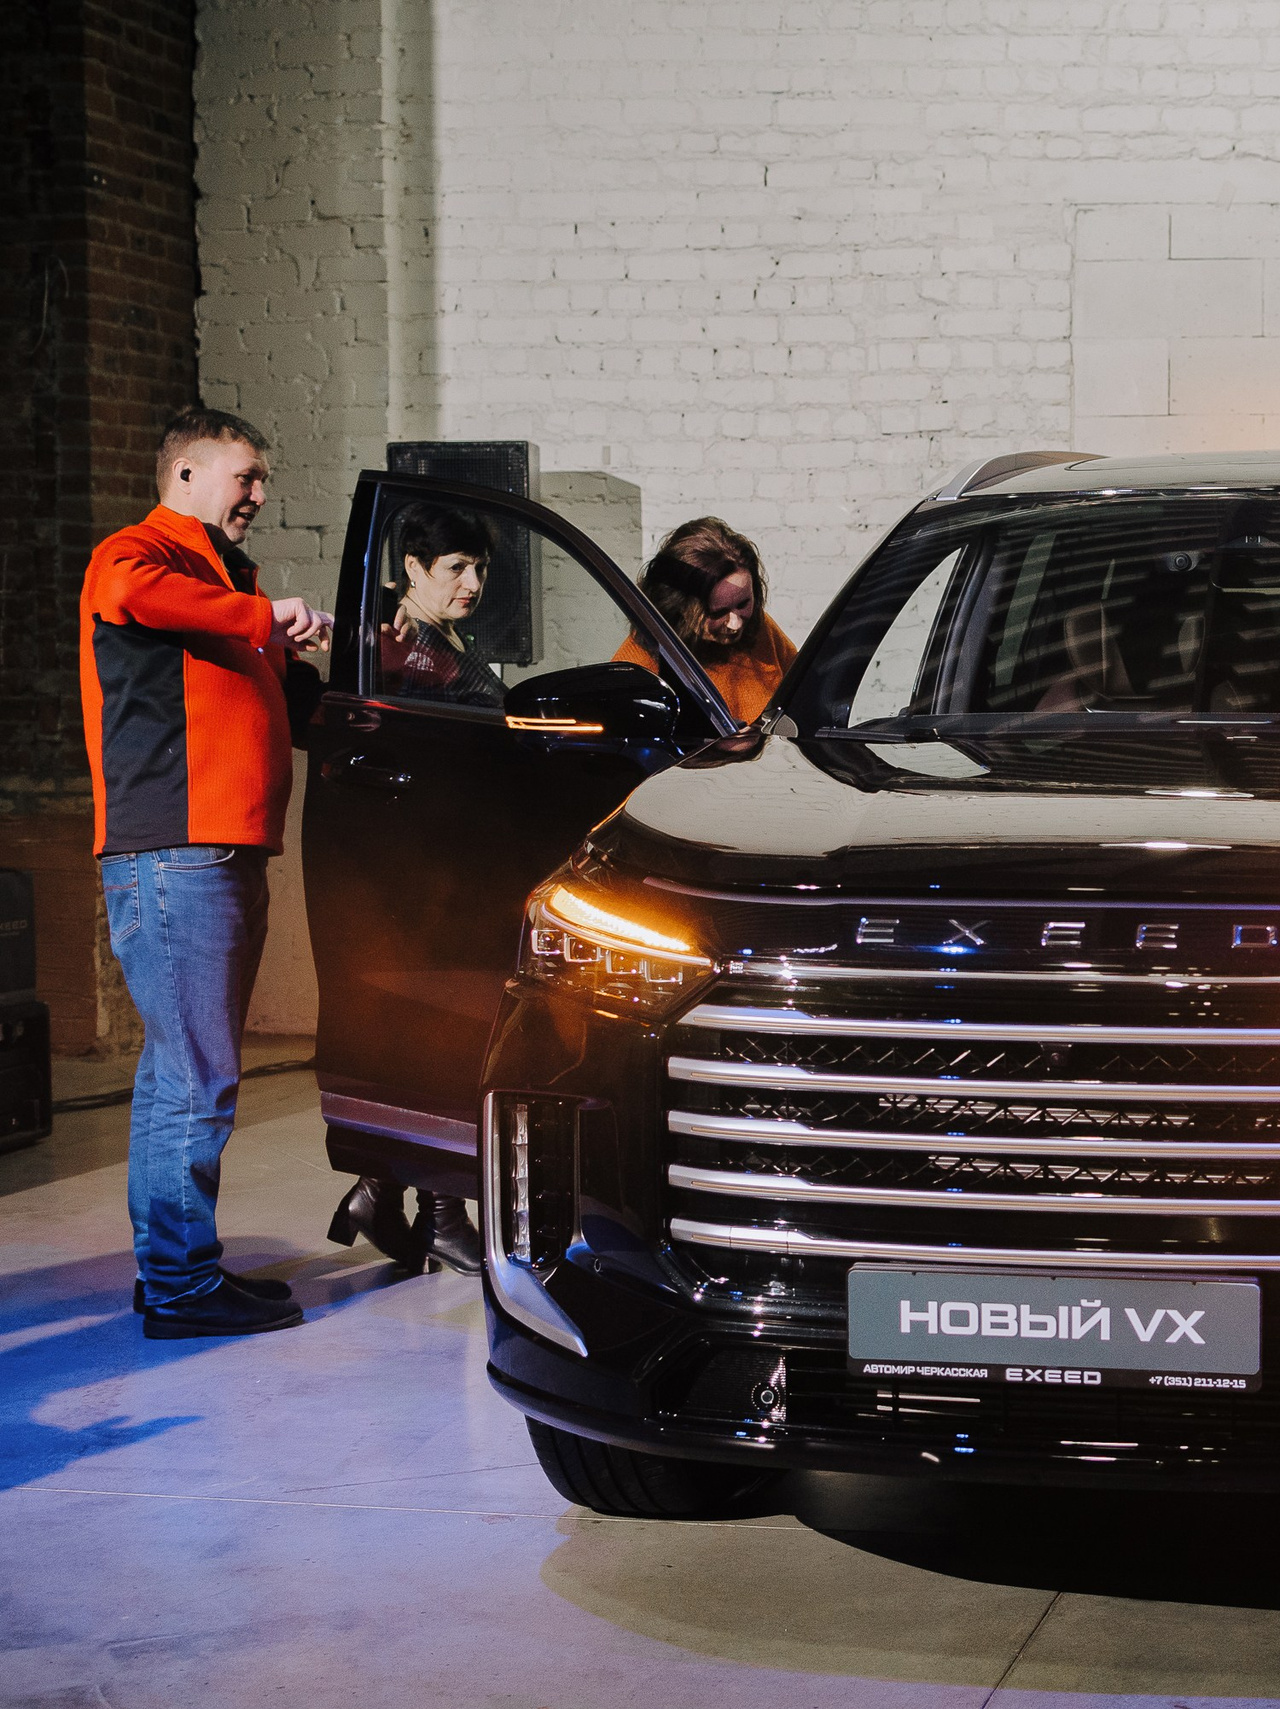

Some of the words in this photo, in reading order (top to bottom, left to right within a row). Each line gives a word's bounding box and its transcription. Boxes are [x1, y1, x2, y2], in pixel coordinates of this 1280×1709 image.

[856, 918, 1278, 949] EXEED
[900, 1299, 1111, 1341] НОВЫЙ
[1124, 1308, 1206, 1344] VX
[863, 1364, 915, 1375] АВТОМИР
[916, 1366, 988, 1378] ЧЕРКАССКАЯ
[1005, 1368, 1101, 1385] EXEED
[1149, 1376, 1162, 1386] +7
[1164, 1376, 1192, 1387] (351)
[1194, 1378, 1246, 1388] 211-12-15
